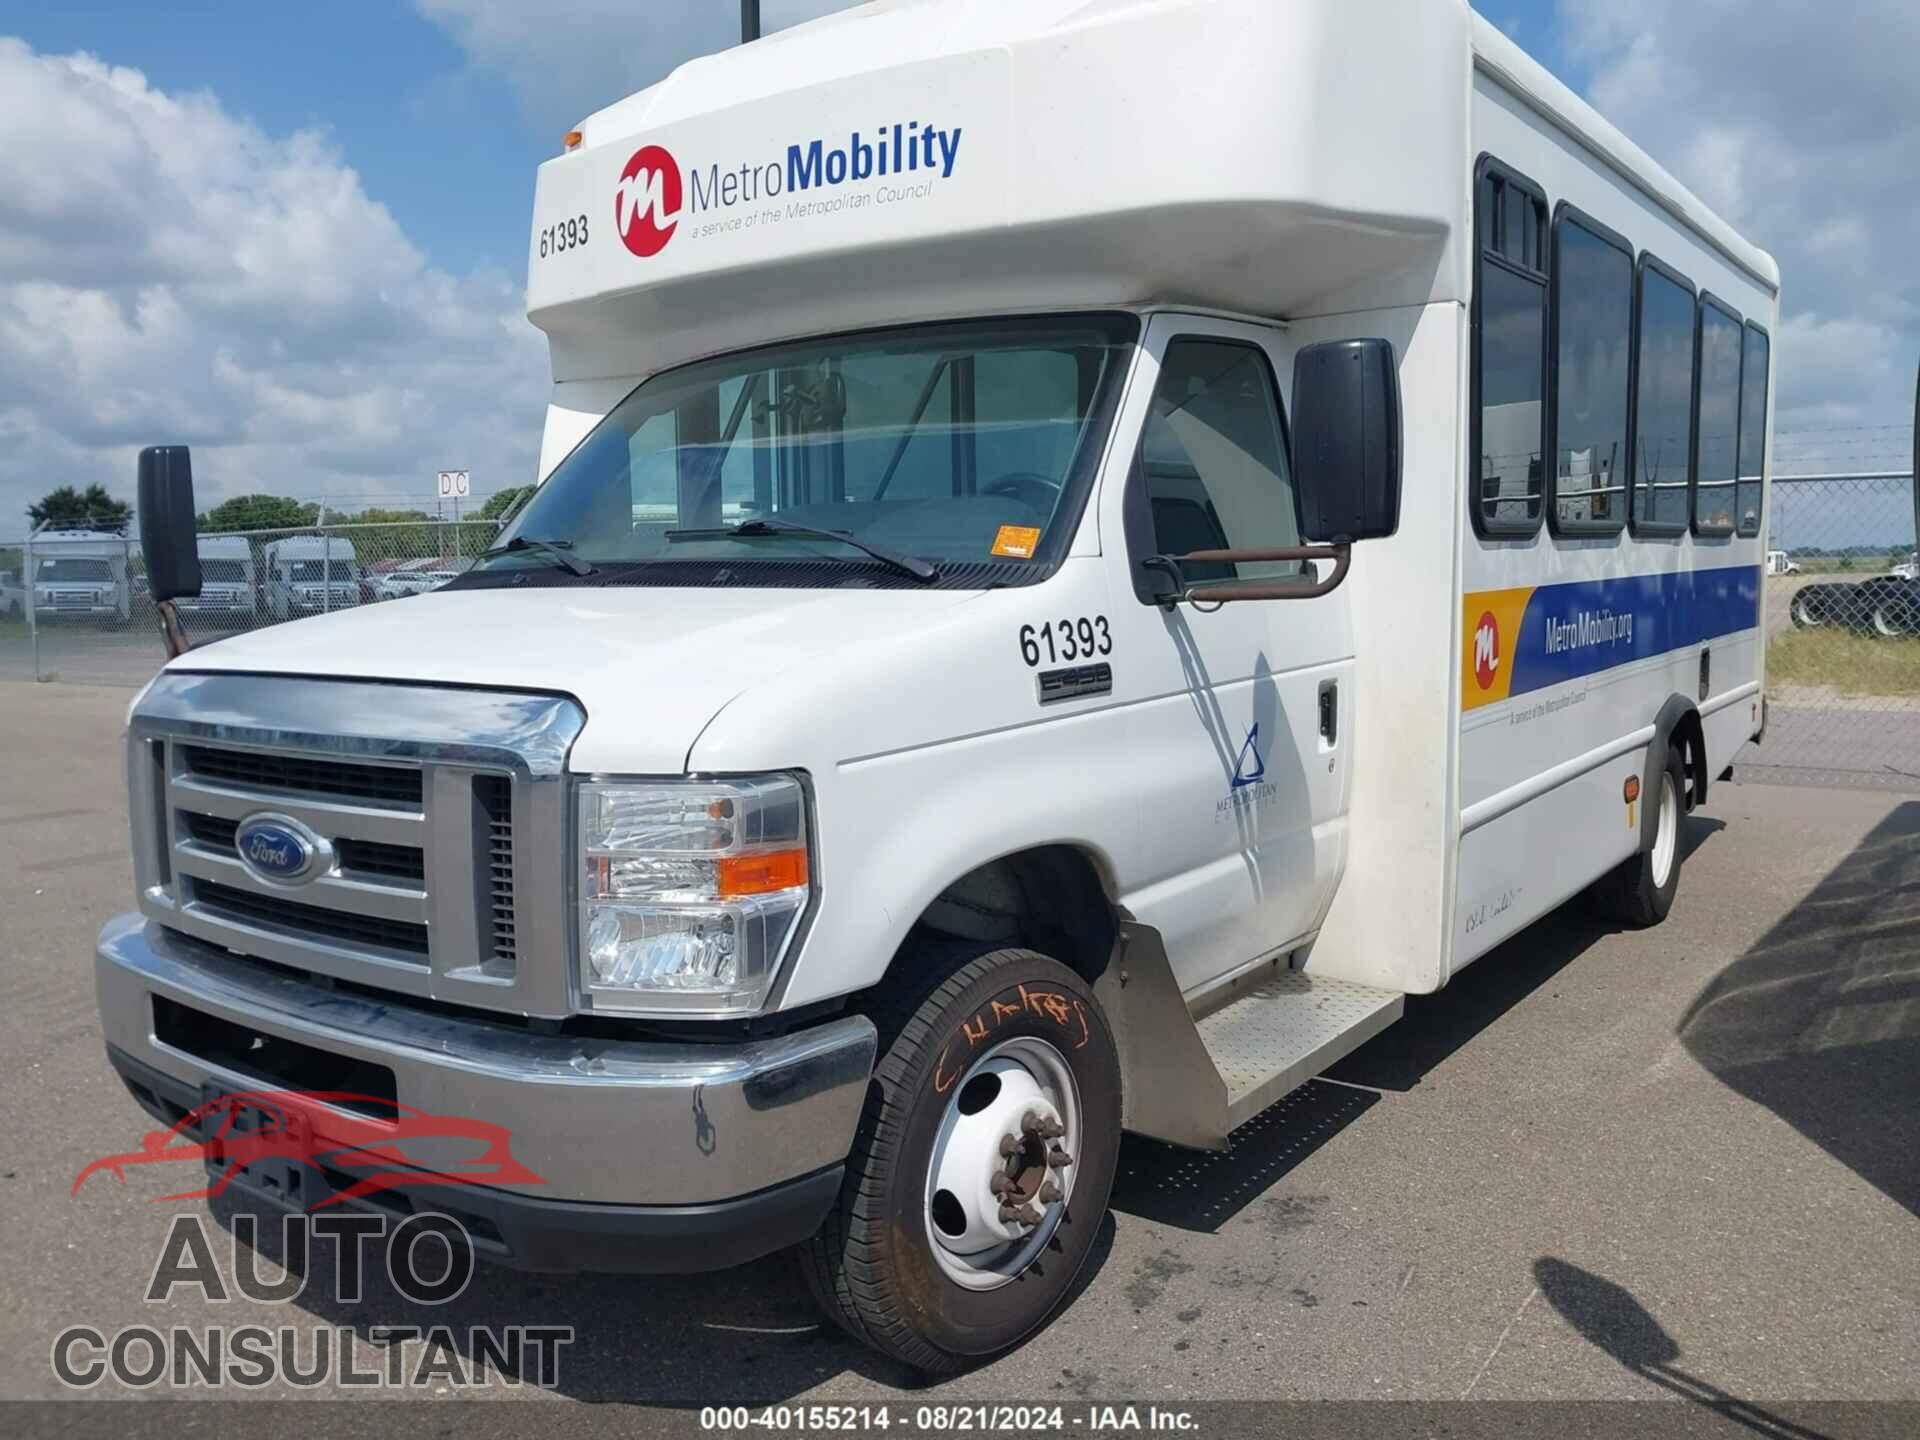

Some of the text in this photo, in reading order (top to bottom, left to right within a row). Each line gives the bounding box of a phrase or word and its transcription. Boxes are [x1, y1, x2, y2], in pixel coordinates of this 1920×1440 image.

[691, 121, 962, 213] MetroMobility
[692, 182, 933, 239] a service of the Metropolitan Council
[540, 215, 589, 259] 61393
[1020, 615, 1112, 667] 61393
[1545, 609, 1632, 655] MetroMobility.org
[250, 832, 288, 866] Ford
